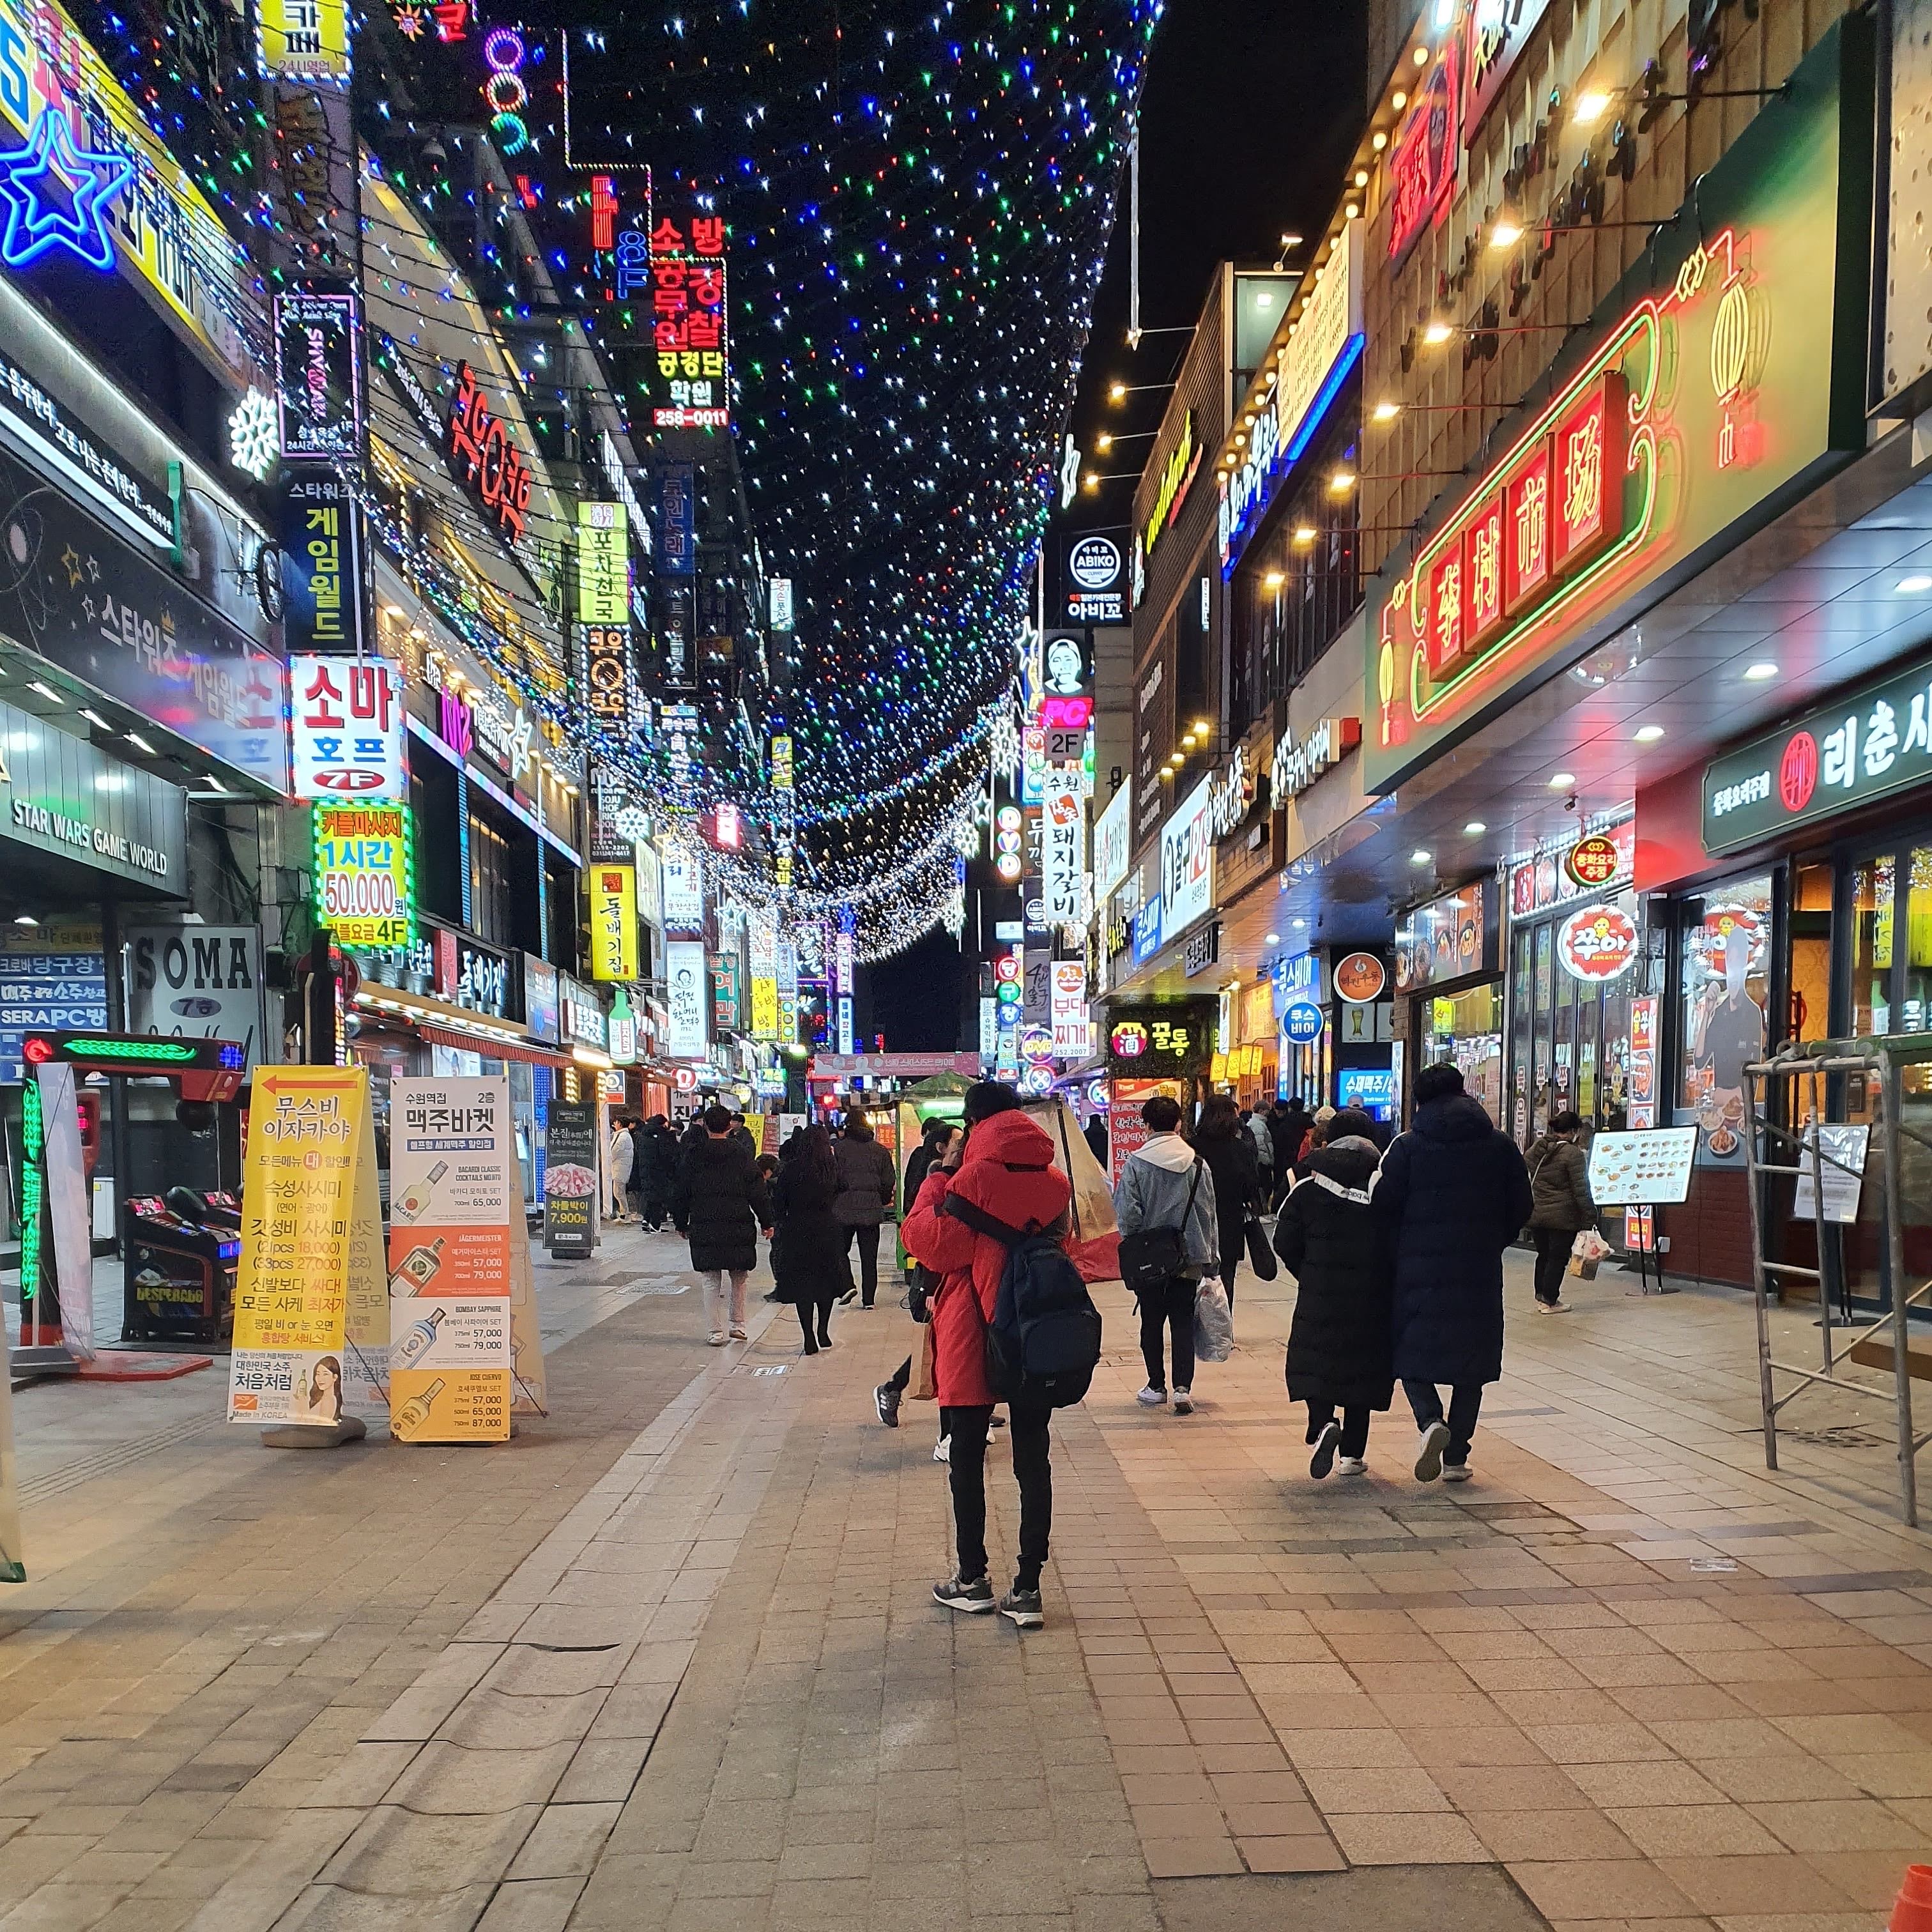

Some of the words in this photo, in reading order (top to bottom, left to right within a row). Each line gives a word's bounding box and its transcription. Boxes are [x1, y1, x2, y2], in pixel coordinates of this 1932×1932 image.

[657, 352, 724, 378] 공경단
[670, 380, 712, 407] 학원
[656, 410, 726, 426] 258-0011
[289, 482, 353, 501] 스타워즈
[1077, 555, 1115, 568] ABIKO
[307, 508, 345, 640] 게임월드
[1068, 602, 1123, 620] 아비꼬
[100, 593, 181, 682] 스타워즈
[304, 665, 394, 732] 소마
[1045, 699, 1087, 728] PC
[311, 736, 387, 763] 호프
[1052, 735, 1080, 754] 2F
[321, 772, 377, 788] 7F
[1047, 776, 1079, 792] 수원
[1713, 770, 1770, 816] 중화요리주점
[321, 810, 402, 838] 커플마사지
[14, 799, 50, 834] STAR
[52, 811, 89, 848] WARS
[93, 828, 127, 861] GAME
[127, 841, 167, 876] WORLD
[323, 841, 394, 869] 1시간
[1575, 853, 1618, 867] 중화요리
[1052, 826, 1080, 916] 돼지갈비
[1584, 866, 1607, 878] 주점
[376, 919, 406, 942] 4F
[599, 896, 624, 974] 돌배기집
[135, 937, 252, 990] SOMA
[1000, 961, 1018, 1022] 당구장
[1054, 997, 1086, 1018] 부대
[1291, 1009, 1315, 1022] 쿠스
[1, 1009, 50, 1023] SERA
[50, 1008, 107, 1027] PC방
[1055, 1025, 1086, 1045] 찌개
[1291, 1025, 1315, 1034] 비어
[1024, 1039, 1053, 1055] DVD
[1119, 1034, 1139, 1054] 酒
[1152, 1022, 1190, 1056] 꿀통
[275, 1096, 339, 1119] 무스비
[406, 1092, 447, 1105] 수원역점
[477, 1092, 495, 1104] 2층
[406, 1108, 494, 1133] 맥주바켓
[264, 1119, 351, 1142] 이자카야
[435, 1140, 466, 1150] 세계맥주
[259, 1155, 302, 1168] 모든메뉴
[305, 1153, 319, 1169] 대
[264, 1180, 342, 1199] 숙성사시미
[473, 1198, 502, 1207] 65,000
[551, 1200, 588, 1211] 차돌박이
[250, 1218, 297, 1238] 갓성비
[302, 1218, 347, 1238] 사시미
[298, 1241, 341, 1255] 18,000)
[253, 1256, 294, 1271] (33pcs
[297, 1258, 341, 1271] 27,000)
[473, 1258, 502, 1268] 57,000
[473, 1270, 502, 1280] 79,000
[250, 1276, 306, 1293] 신발보다
[240, 1296, 271, 1312] 모든
[275, 1296, 303, 1312] 사케
[307, 1297, 346, 1314] 최저가
[254, 1318, 273, 1331] 평일
[275, 1319, 285, 1331] 비
[288, 1321, 298, 1329] or
[300, 1320, 311, 1331] 눈
[314, 1320, 334, 1331] 오면
[473, 1329, 502, 1338] 57,000
[473, 1341, 502, 1351] 79,000
[236, 1360, 272, 1372] 대한민국
[235, 1372, 293, 1391] 처음처럼
[473, 1396, 502, 1405] 57,000
[261, 1411, 288, 1419] KOREA
[472, 1407, 502, 1416] 65,000
[472, 1419, 502, 1428] 87,000
